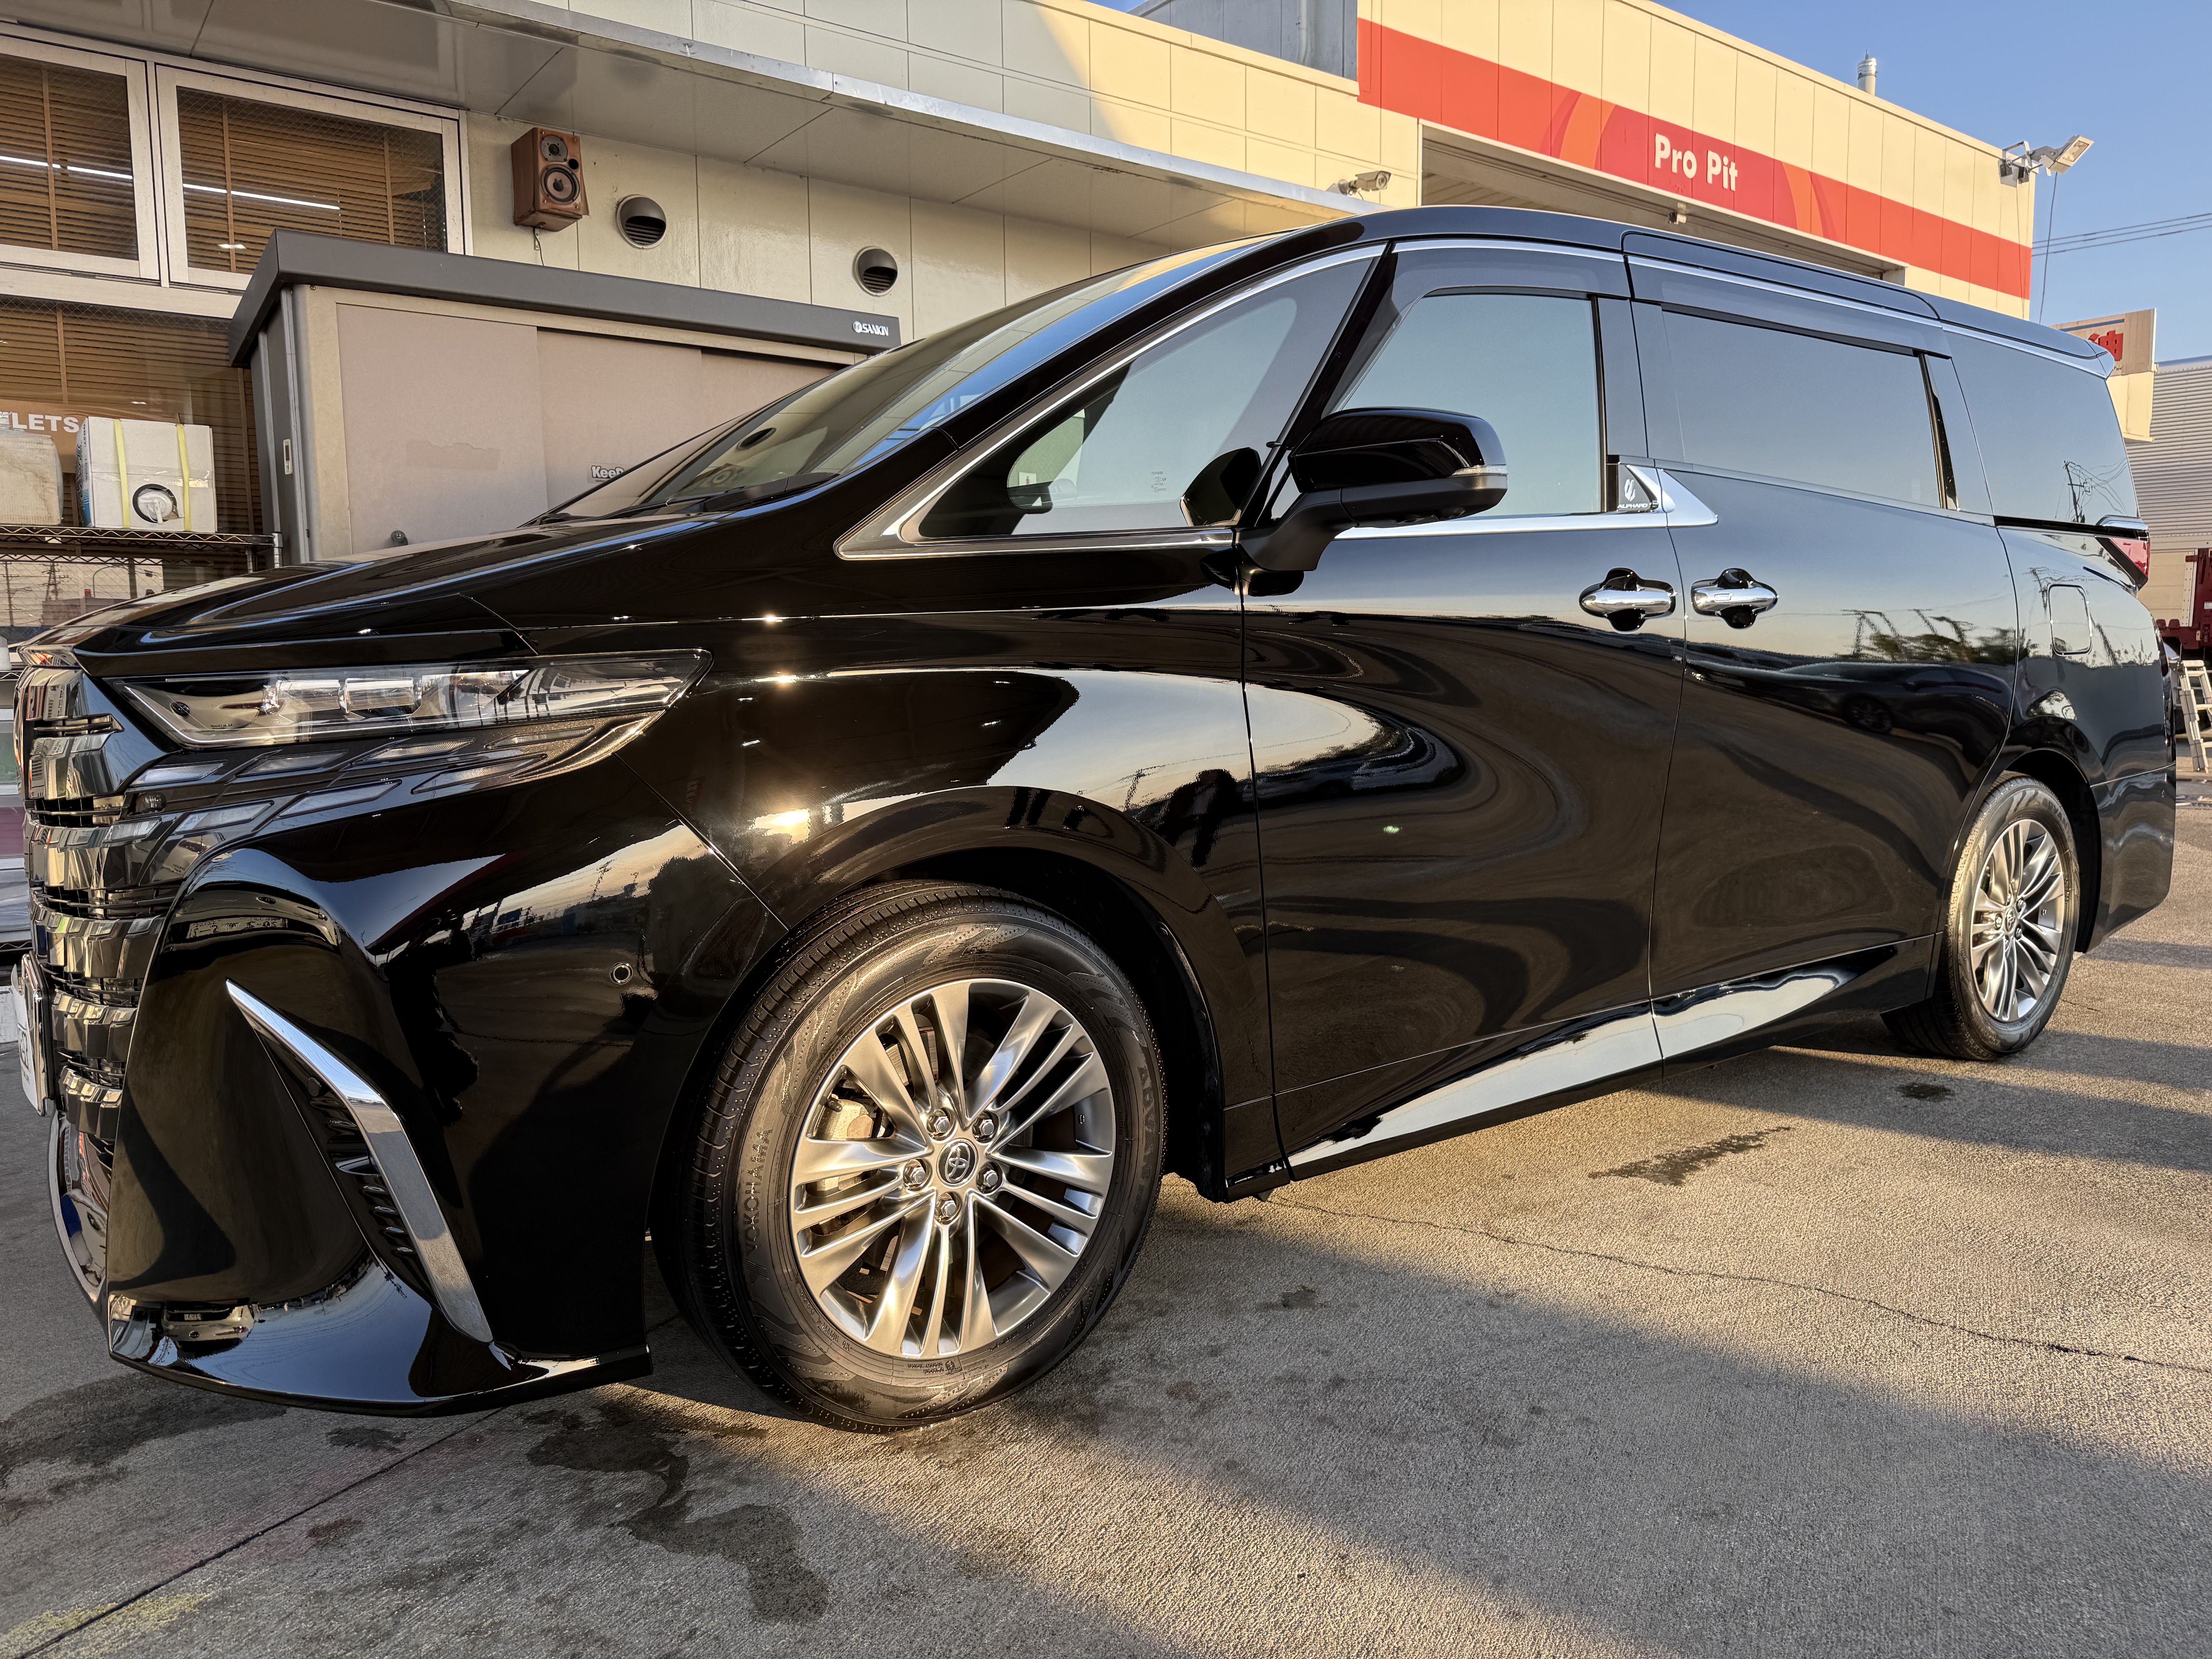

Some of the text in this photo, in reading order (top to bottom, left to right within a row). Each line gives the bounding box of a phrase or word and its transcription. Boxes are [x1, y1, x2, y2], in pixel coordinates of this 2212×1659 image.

[1654, 132, 1738, 191] Pro Pit
[861, 323, 889, 336] SANKIN
[1139, 1067, 1154, 1178] ADVAN
[743, 1129, 773, 1257] YOKOHAMA
